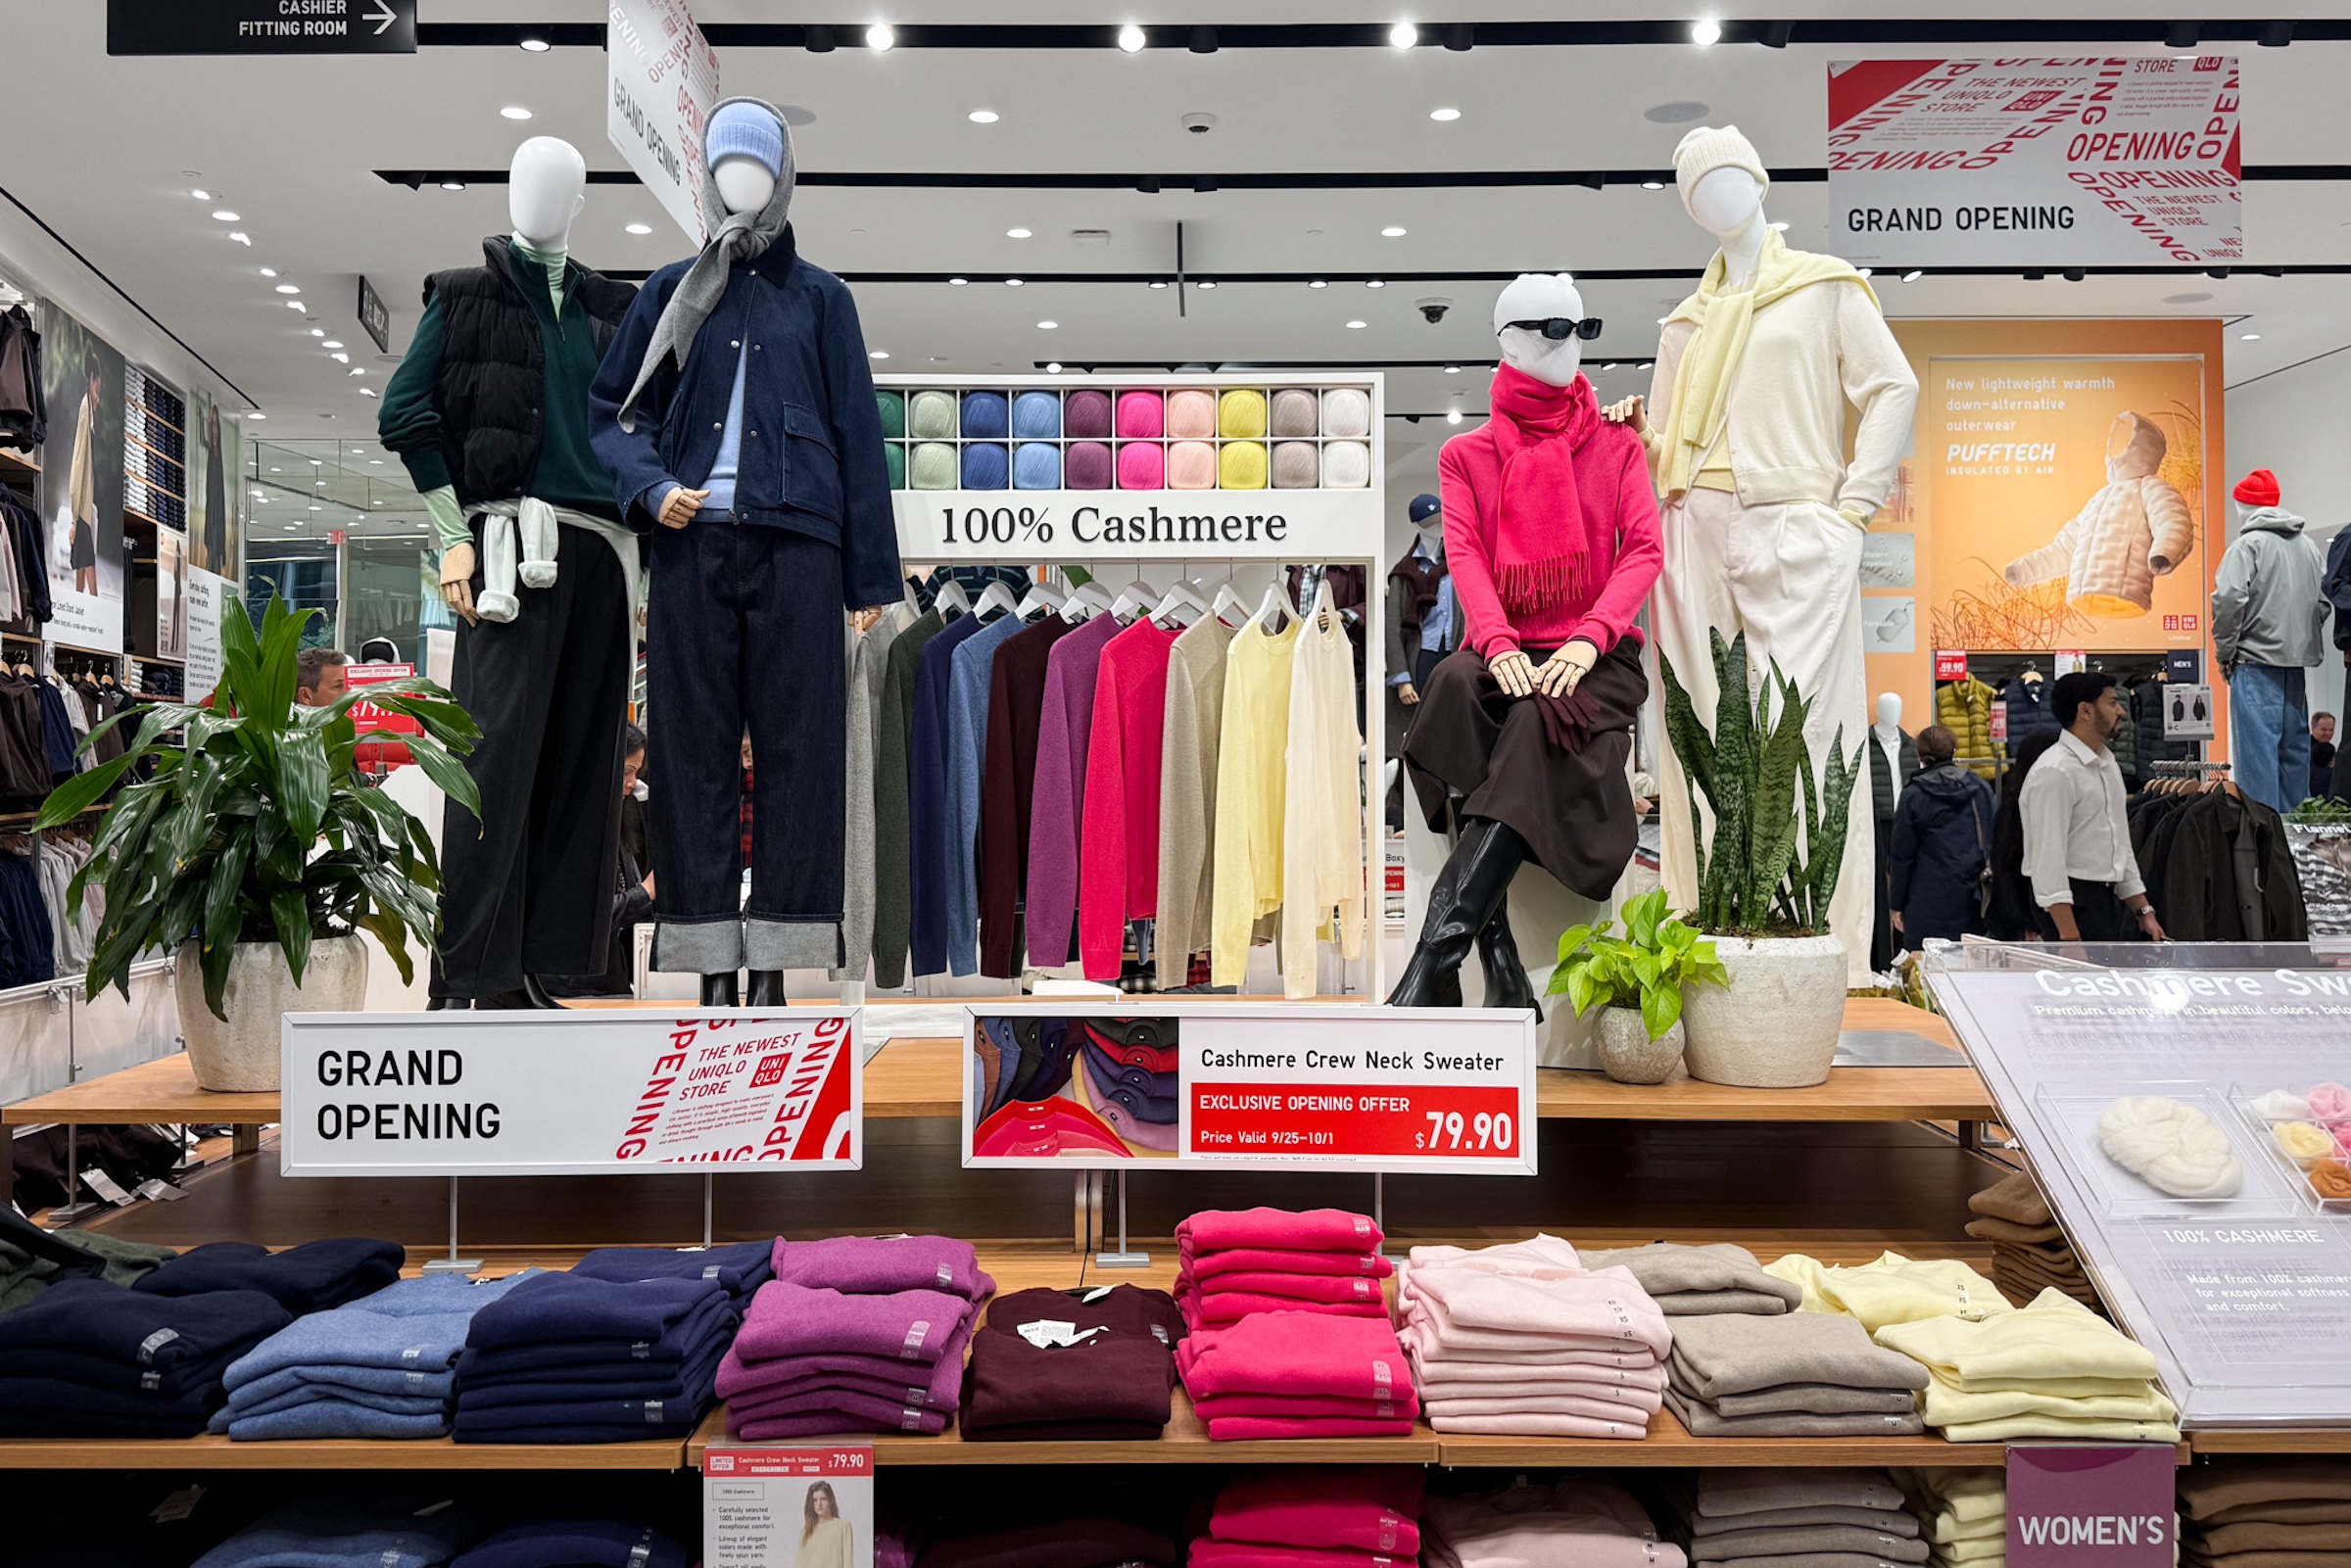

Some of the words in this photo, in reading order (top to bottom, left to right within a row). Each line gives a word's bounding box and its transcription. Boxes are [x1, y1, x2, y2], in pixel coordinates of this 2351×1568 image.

[278, 0, 347, 15] CASHIER
[239, 21, 301, 36] FITTING
[304, 21, 347, 35] ROOM
[2134, 59, 2178, 73] STORE
[1964, 77, 2004, 87] THE
[2002, 77, 2087, 87] NEWEST
[1942, 90, 2013, 100] UNIQLO
[614, 77, 645, 139] GRAND
[1921, 103, 1986, 113] STORE
[647, 121, 681, 186] OPENING
[2067, 130, 2195, 162] OPENING
[2098, 169, 2237, 190] OPENING
[2133, 196, 2162, 205] THE
[2163, 195, 2223, 205] NEWEST
[2067, 172, 2201, 261] OPENING
[2147, 207, 2201, 215] UNIQLO
[1847, 207, 1943, 232] GRAND
[1955, 206, 2075, 230] OPENING
[2161, 216, 2210, 226] STORE
[1945, 378, 1975, 390] New
[1982, 377, 2056, 393] lightweight
[2063, 377, 2115, 390] warmth
[1945, 398, 2065, 411] down-alternative
[1945, 419, 2016, 431] outerwear
[1946, 443, 2056, 462] PUFFTECH
[1945, 465, 2009, 476] INSULATED
[2015, 465, 2029, 475] BY
[2036, 465, 2055, 475] AIR
[942, 506, 1055, 543] 100%
[1072, 505, 1288, 543] Cashmere
[1385, 853, 1405, 864] Boxy
[2035, 970, 2263, 997] Cashmere
[2275, 969, 2351, 996] Sw
[2034, 1005, 2103, 1016] Premium
[2199, 1005, 2266, 1016] beautiful
[2270, 1005, 2319, 1017] colors,
[698, 1044, 732, 1063] THE
[734, 1032, 802, 1057] NEWEST
[760, 1057, 785, 1071] UNI
[1201, 1048, 1296, 1068] Cashmere
[1306, 1050, 1356, 1069] Crew
[1366, 1051, 1414, 1069] Neck
[1423, 1051, 1504, 1070] Sweater
[317, 1050, 462, 1086] GRAND
[688, 1059, 747, 1081] UNIQLO
[754, 1071, 781, 1085] QLO
[679, 1079, 732, 1101] STORE
[1200, 1094, 1281, 1111] EXCLUSIVE
[1287, 1095, 1354, 1111] OPENING
[1359, 1096, 1411, 1112] OFFER
[317, 1103, 501, 1140] OPENING
[1200, 1130, 1233, 1143] Price
[1237, 1130, 1267, 1144] Valid
[2163, 1230, 2211, 1243] 100%
[2215, 1229, 2325, 1243] CASHMERE
[2185, 1273, 2221, 1284] Made
[2225, 1273, 2257, 1284] from
[2260, 1273, 2293, 1284] 100%
[2297, 1273, 2351, 1284] cashmer
[2195, 1288, 2215, 1298] for
[2221, 1288, 2294, 1299] exceptional
[2297, 1287, 2351, 1298] softness
[2206, 1302, 2230, 1311] and
[2233, 1302, 2291, 1311] comfort.
[2018, 1515, 2165, 1545] WOMEN'S
